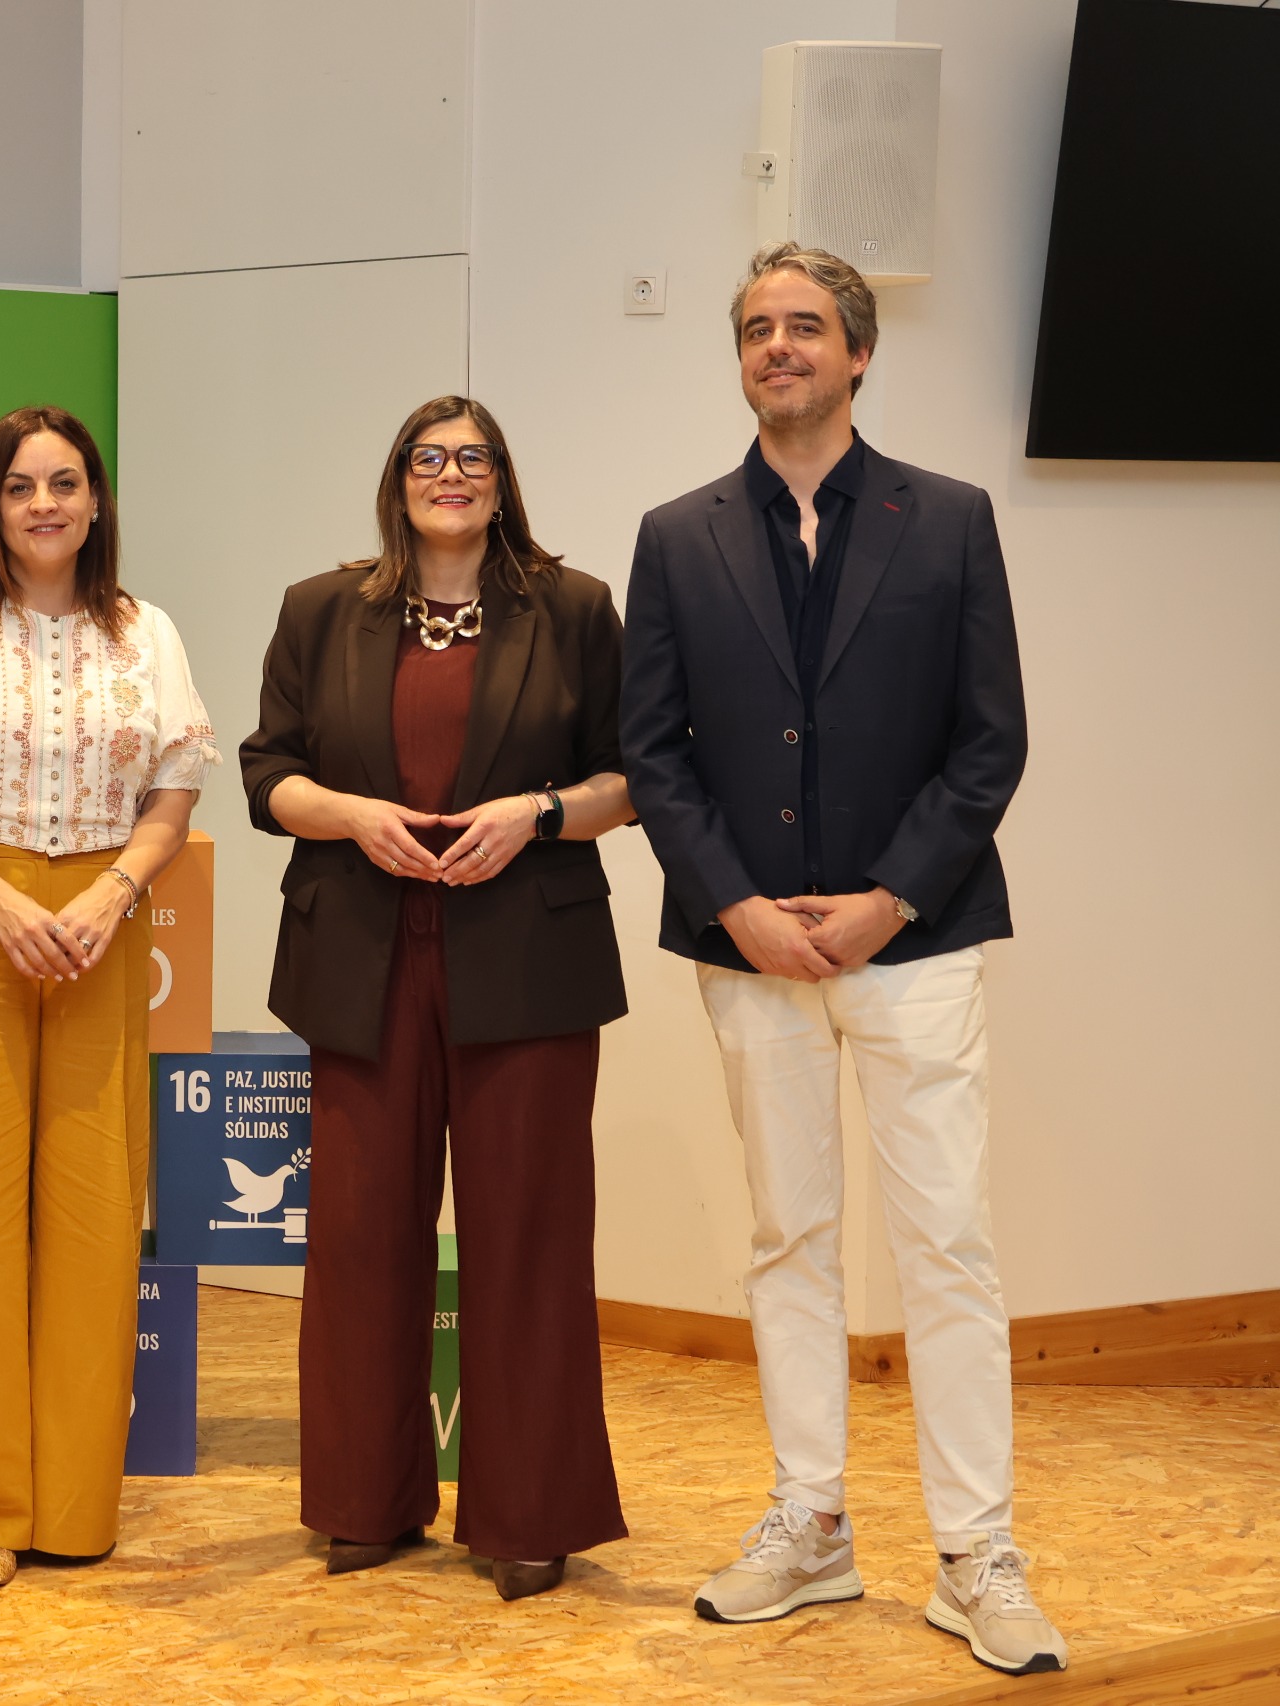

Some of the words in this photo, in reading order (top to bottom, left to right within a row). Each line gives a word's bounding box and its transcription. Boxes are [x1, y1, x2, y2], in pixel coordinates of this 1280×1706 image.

[225, 1071, 257, 1090] PAZ,
[169, 1070, 211, 1113] 16
[225, 1096, 234, 1113] E
[225, 1117, 289, 1139] SÓLIDAS
[136, 1282, 161, 1300] RA
[136, 1332, 160, 1351] OS
